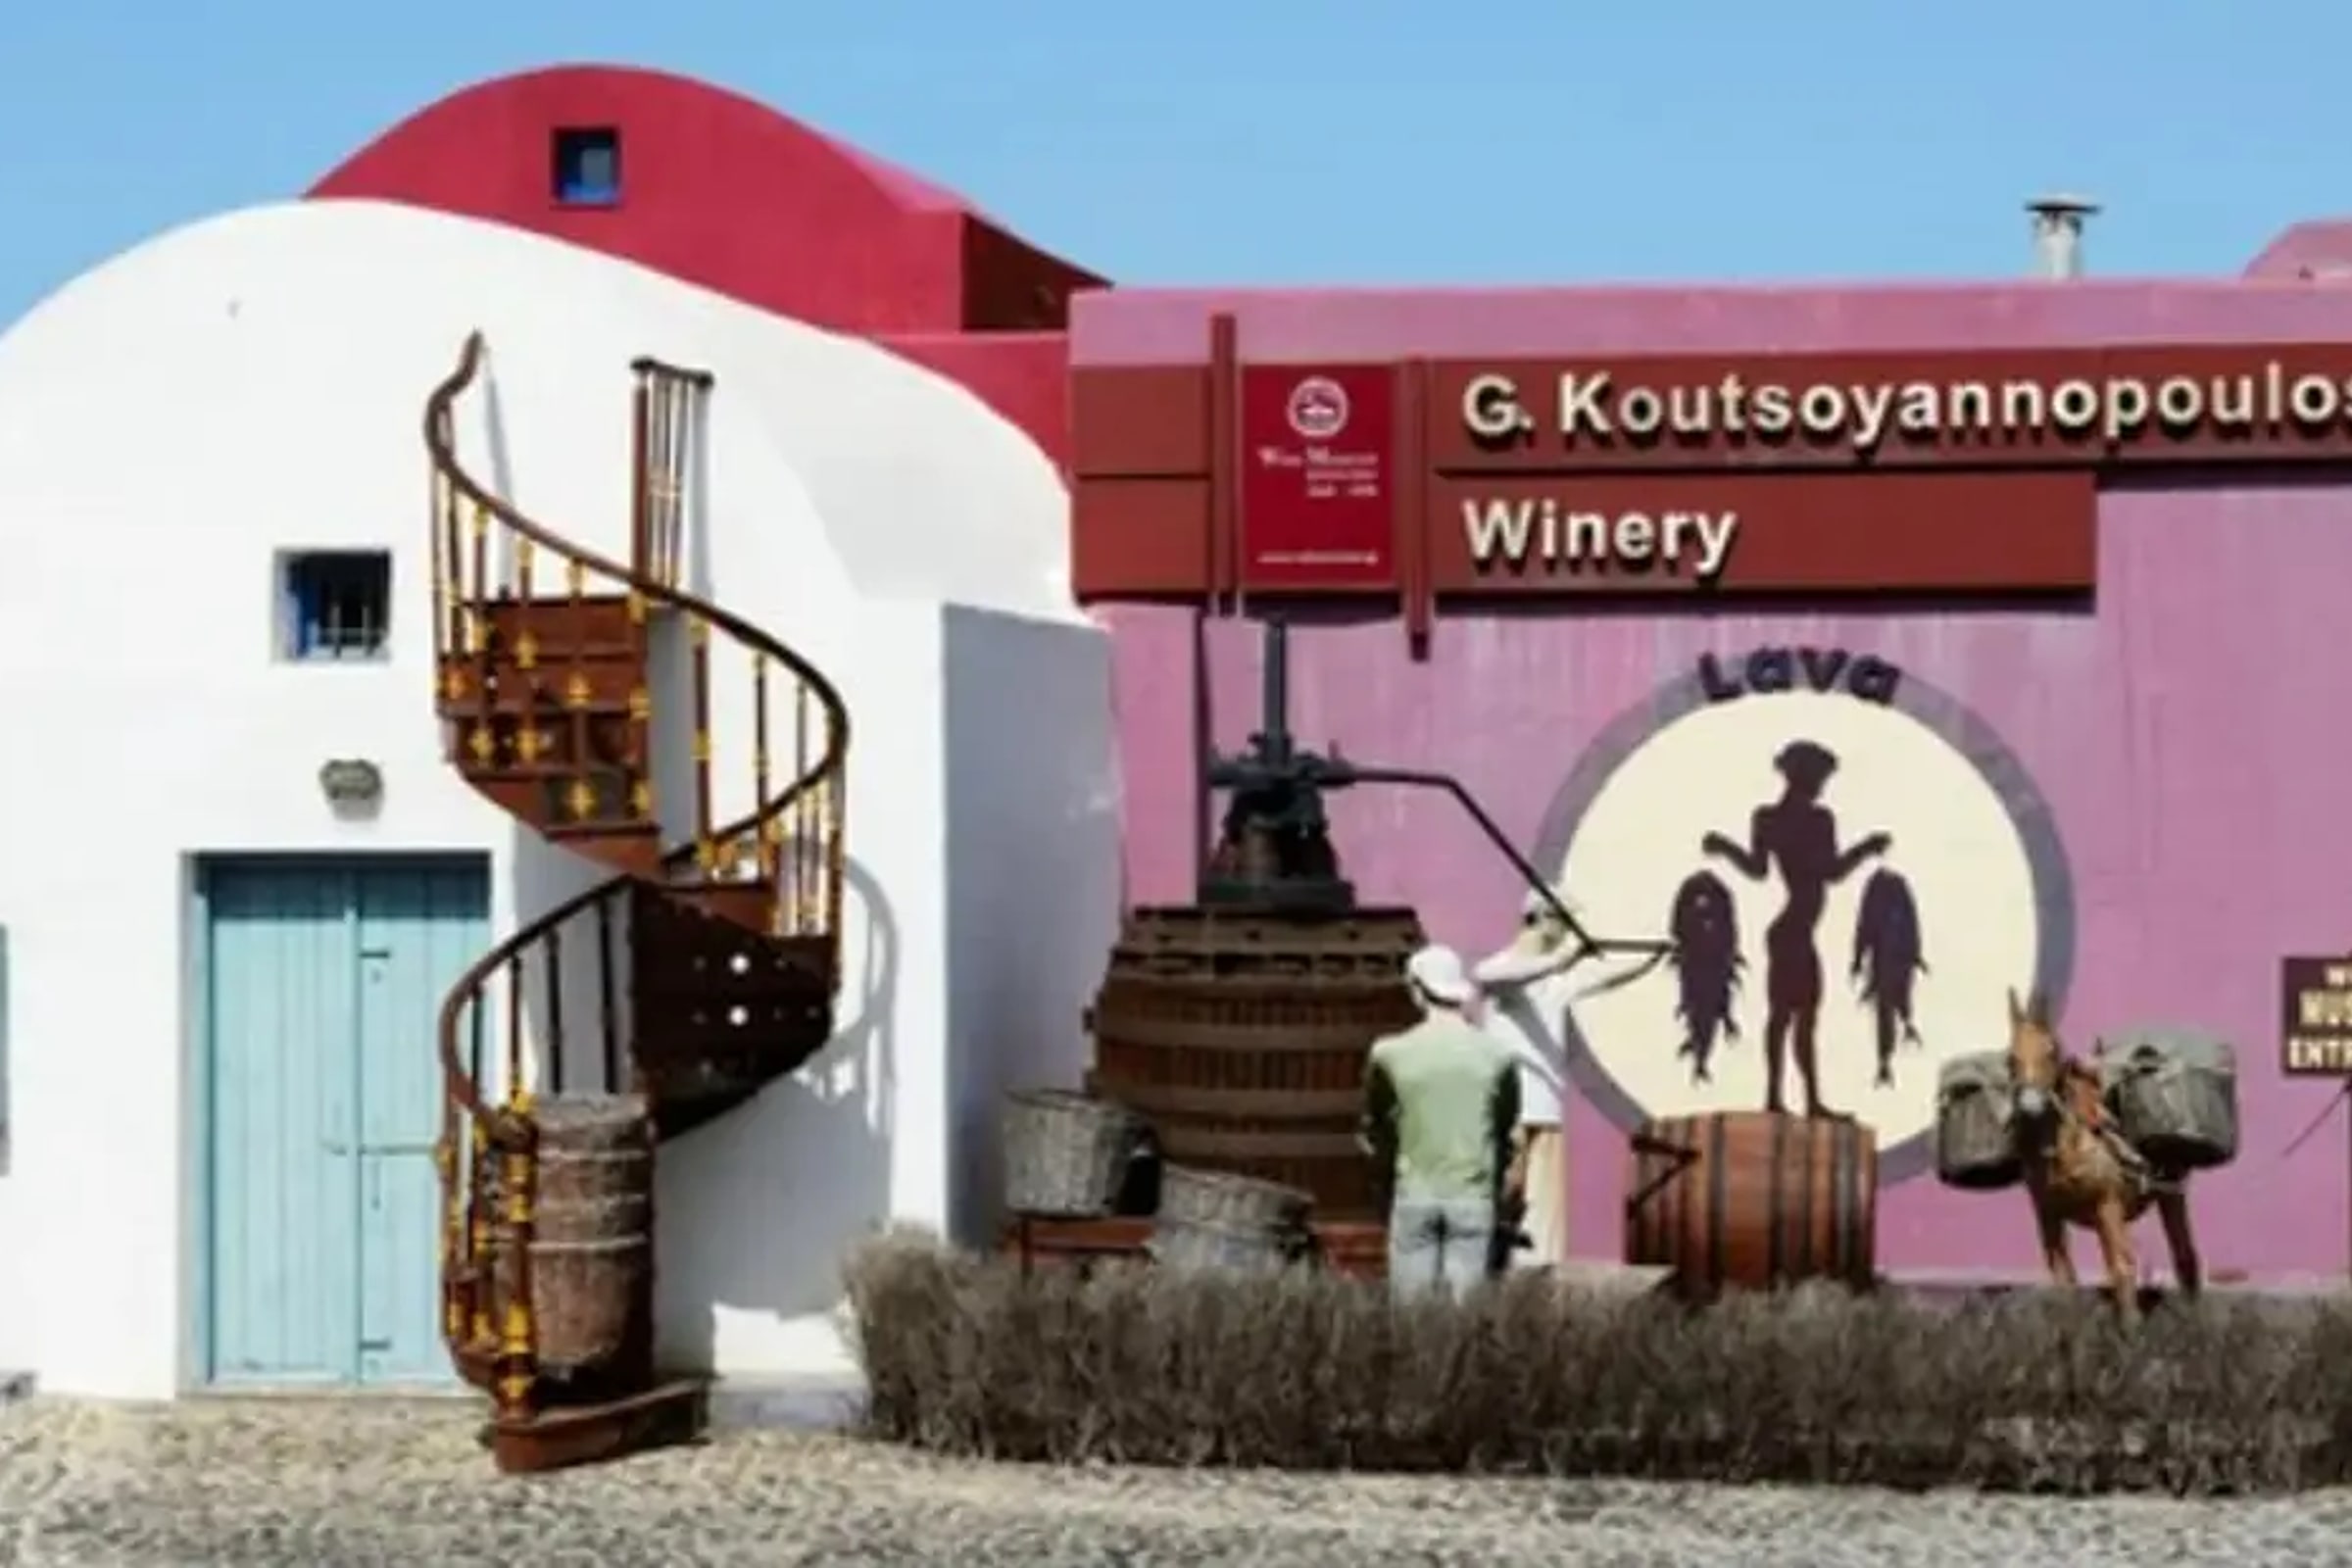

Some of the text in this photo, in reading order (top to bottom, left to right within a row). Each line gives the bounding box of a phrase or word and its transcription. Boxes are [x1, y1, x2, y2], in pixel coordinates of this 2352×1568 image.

[1462, 360, 2352, 448] G. Koutsoyannopoulo
[1461, 498, 1739, 576] Winery
[1697, 642, 1903, 707] Lava
